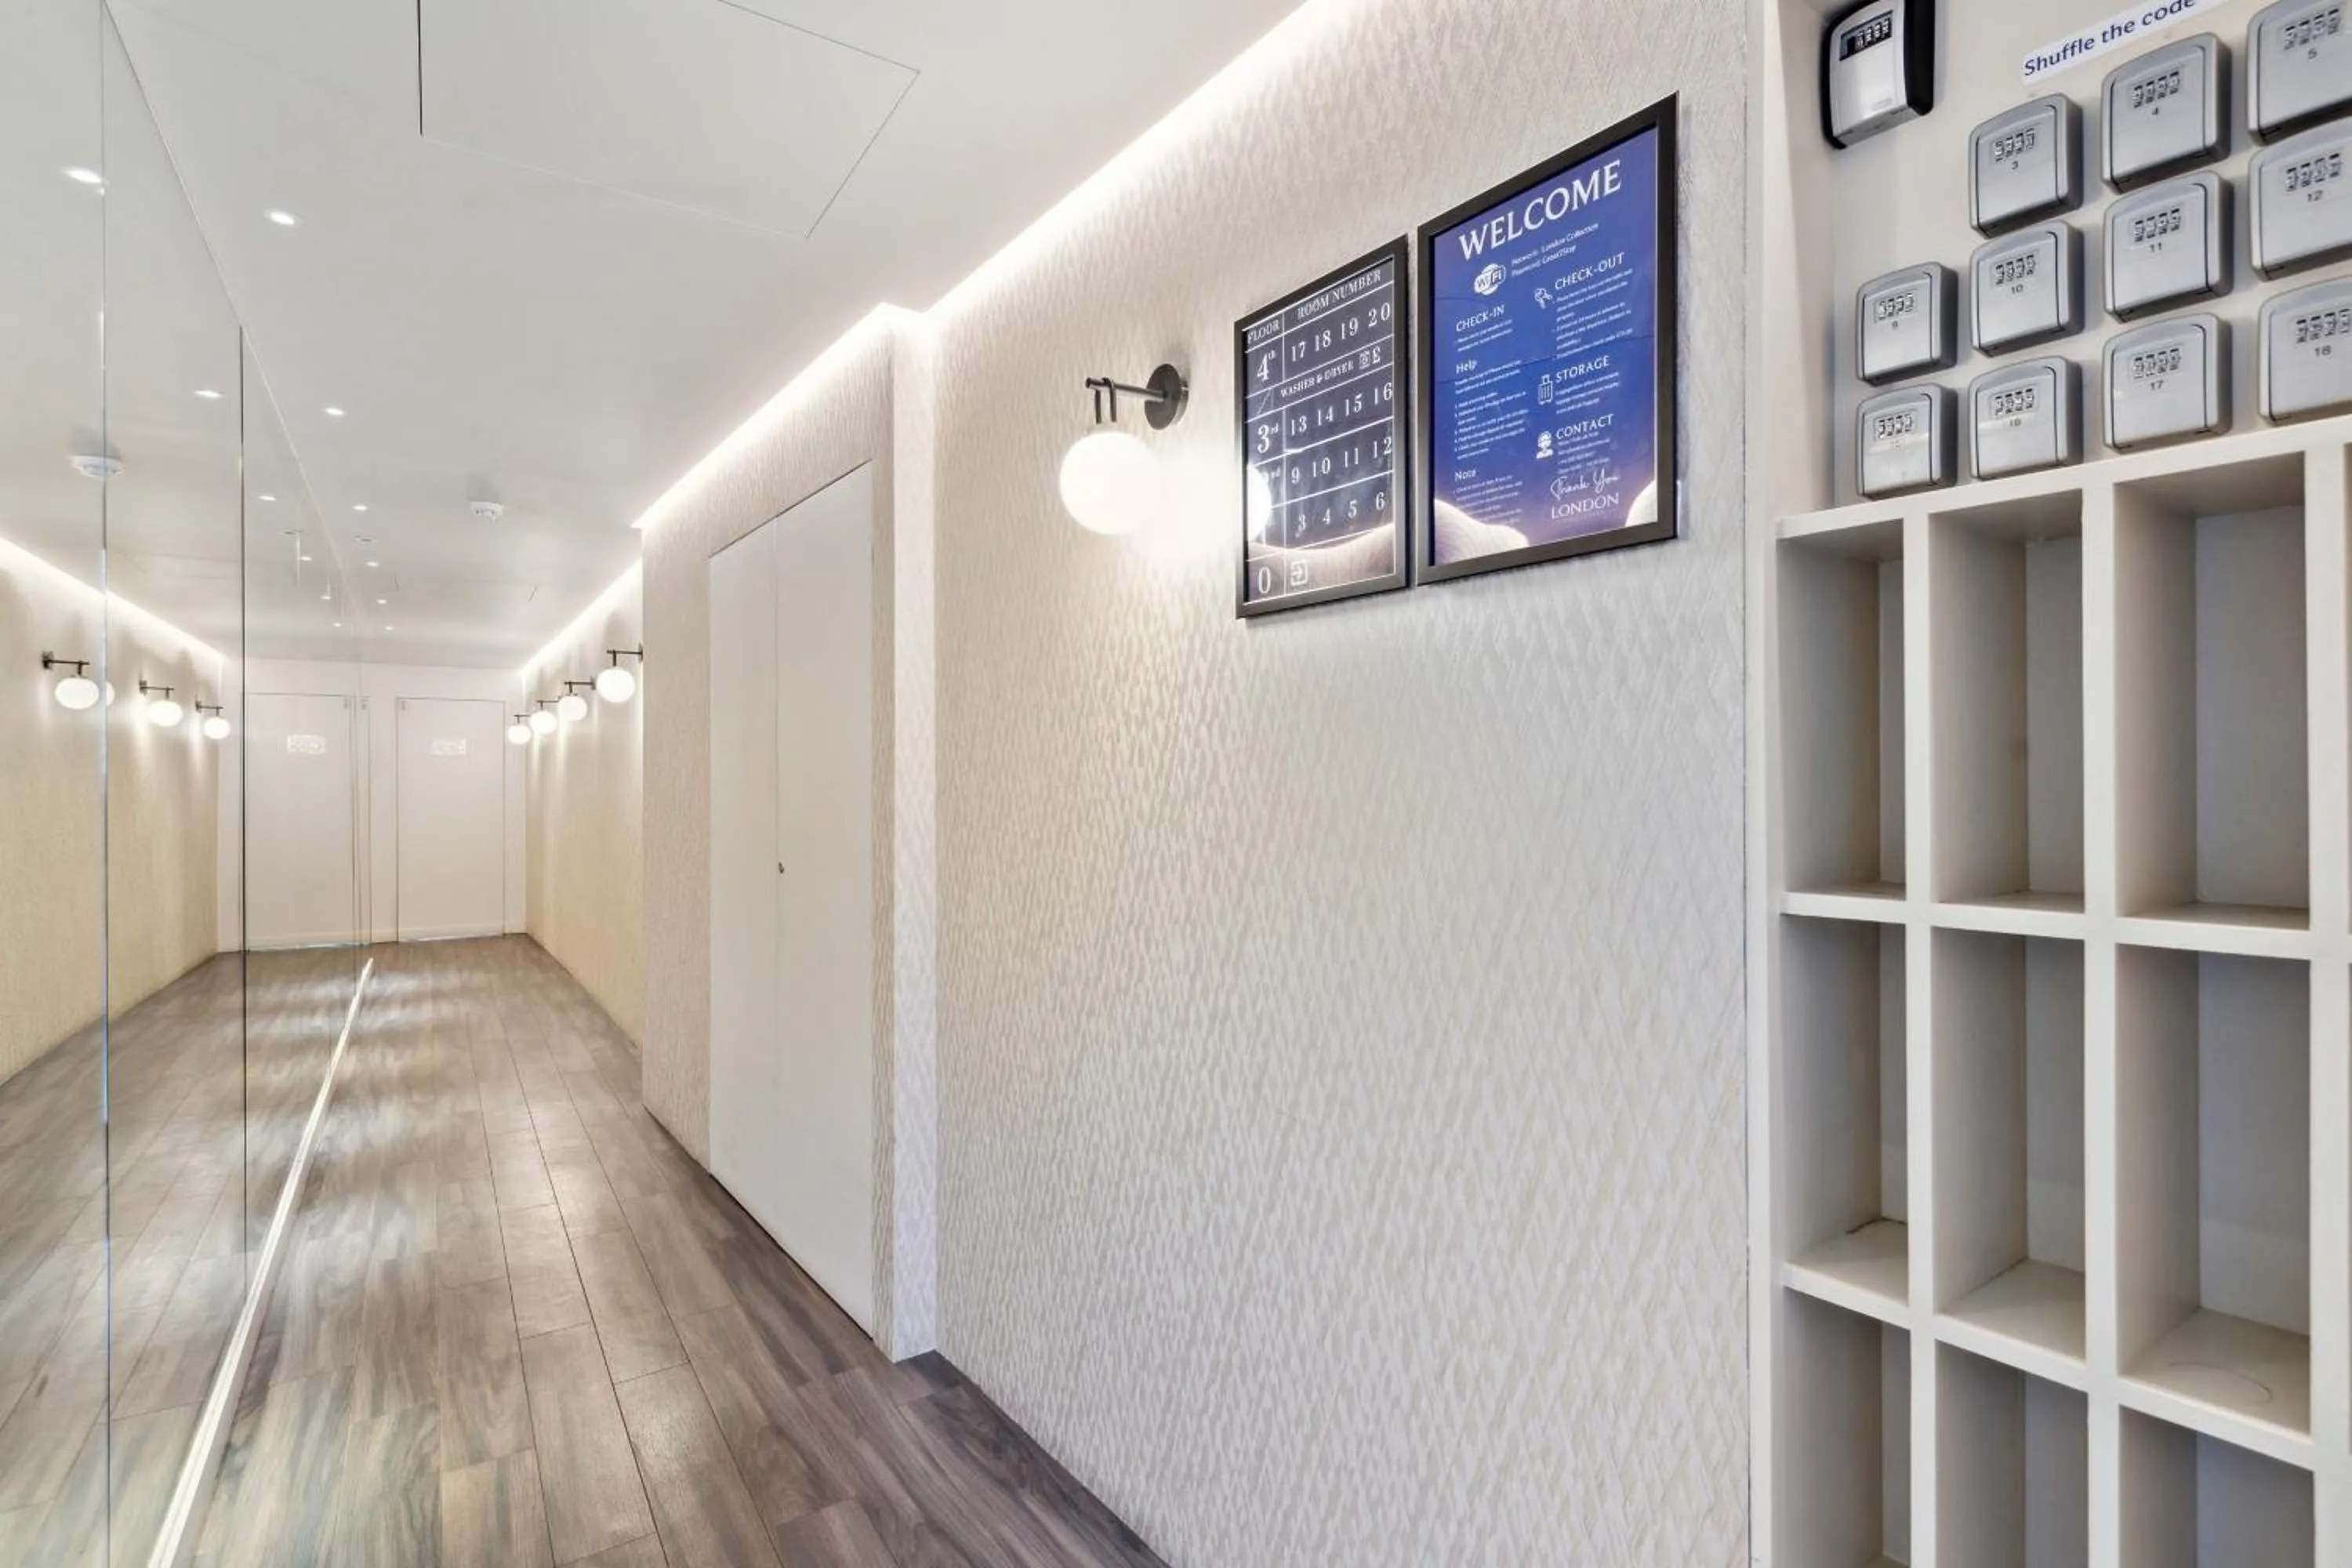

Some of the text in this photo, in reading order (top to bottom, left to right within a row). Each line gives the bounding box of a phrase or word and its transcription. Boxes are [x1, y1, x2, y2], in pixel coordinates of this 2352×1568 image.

[2024, 38, 2095, 76] Shuffle
[2102, 20, 2135, 43] the
[1458, 159, 1621, 261] WELCOME
[1555, 251, 1624, 290] CHECK-OUT
[1247, 269, 1381, 345] FLOOR ROOM NUMBER
[1456, 304, 1504, 332] CHECK-IN
[1257, 302, 1391, 382] 4th 17 18 19 20
[1456, 359, 1478, 375] Help
[1555, 354, 1610, 383] STORAGE
[1280, 377, 1315, 397] WASHER
[1291, 416, 1308, 437] 13
[1317, 405, 1334, 426] 14
[1345, 393, 1363, 416] 15
[1374, 381, 1393, 405] 16
[1556, 413, 1615, 441] CONTACT
[1290, 466, 1301, 484] 9
[1312, 457, 1331, 478] 10
[1345, 448, 1359, 468] 11
[1373, 436, 1393, 459] 12
[1550, 475, 1591, 501] Thank
[1323, 508, 1331, 525] 4
[1348, 499, 1358, 520] 5
[1375, 492, 1386, 510] 6
[1552, 492, 1620, 519] LONDON
[1258, 566, 1272, 594] 0
